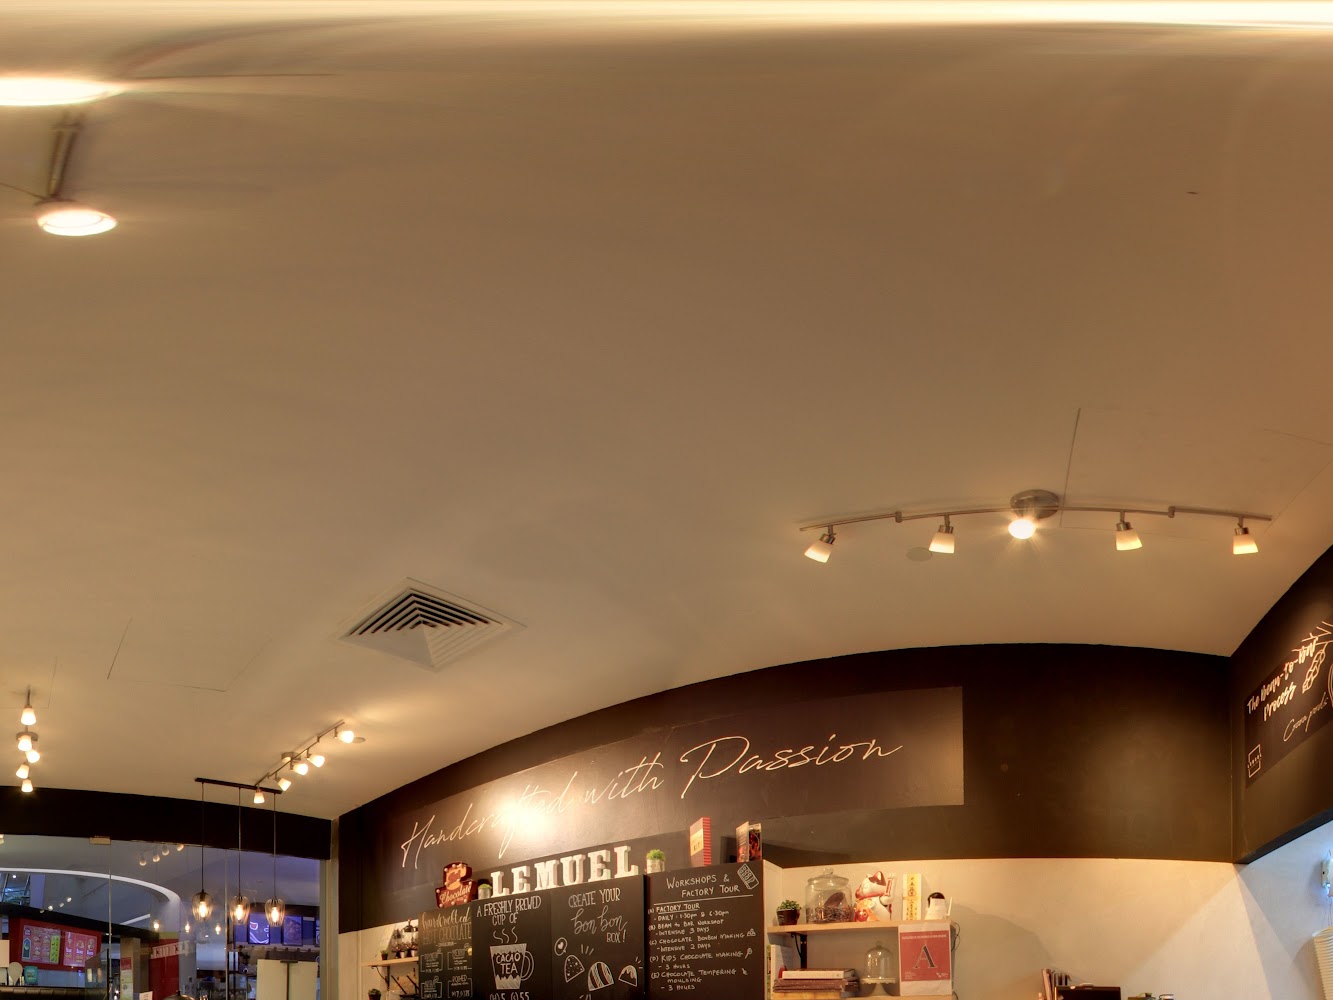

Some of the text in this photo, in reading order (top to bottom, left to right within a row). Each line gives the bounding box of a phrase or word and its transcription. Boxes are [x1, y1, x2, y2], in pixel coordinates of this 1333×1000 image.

[584, 751, 665, 804] with
[680, 733, 904, 799] Passion
[490, 845, 639, 898] LEMUEL
[666, 873, 730, 890] WORKSHOPS &
[439, 882, 472, 903] Chocolate
[568, 887, 621, 908] CREATE YOUR
[681, 884, 740, 898] FACTORY TOUR
[476, 895, 542, 918] A FRESHLY BREWED
[656, 904, 681, 913] FACTORY
[683, 902, 700, 910] TOUR
[492, 912, 519, 926] CUP OF
[572, 904, 628, 935] bon bon
[697, 918, 724, 926] WORKSHOP
[440, 922, 472, 942] CHOCOLATE
[658, 936, 692, 945] CHOCOLATE
[496, 952, 521, 964] CACAO
[661, 954, 677, 963] KIDS
[680, 953, 713, 961] CHOCOLATE
[912, 944, 937, 969] A
[501, 963, 518, 975] TEA
